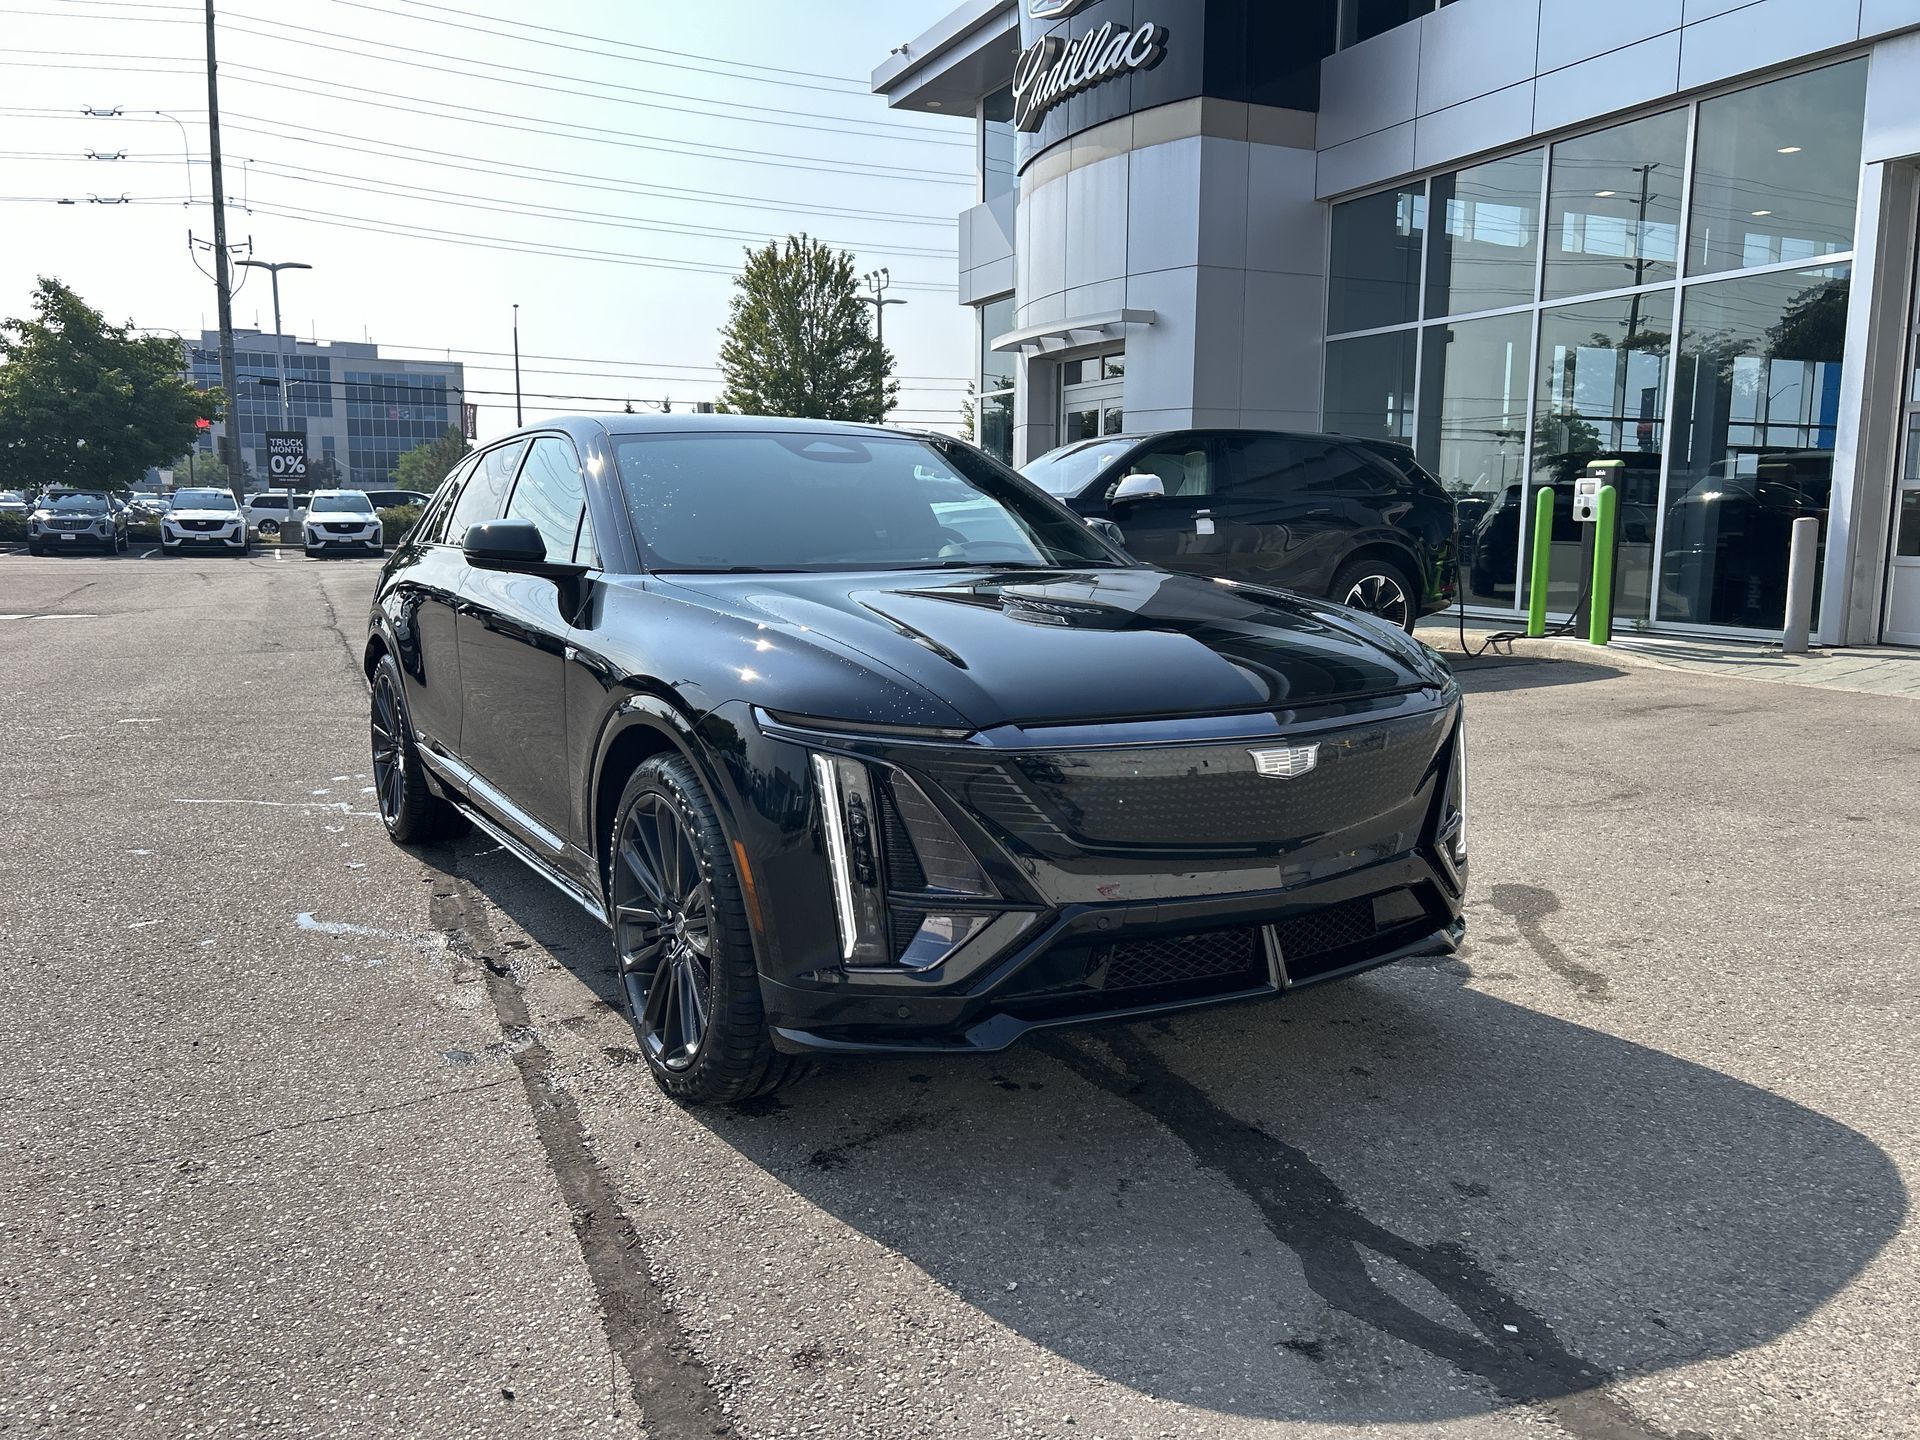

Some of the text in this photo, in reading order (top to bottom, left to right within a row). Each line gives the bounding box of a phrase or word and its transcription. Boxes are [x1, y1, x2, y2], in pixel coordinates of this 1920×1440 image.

[1012, 21, 1155, 132] Cadillac
[270, 438, 304, 447] TRUCK
[270, 446, 304, 454] MONTH
[270, 455, 306, 474] 0%
